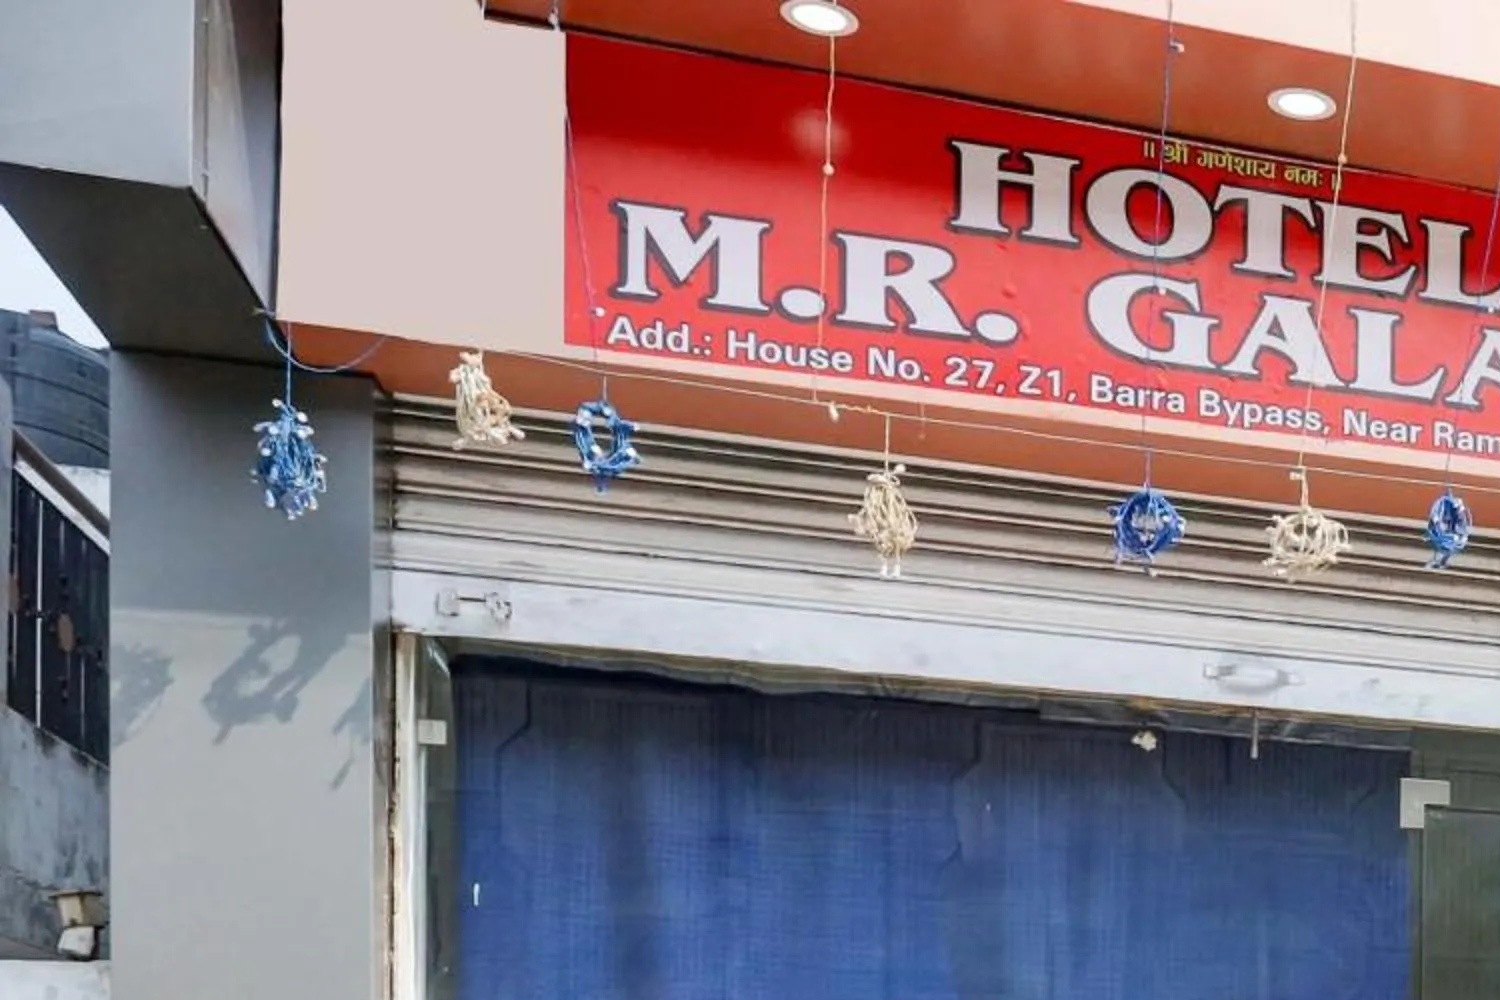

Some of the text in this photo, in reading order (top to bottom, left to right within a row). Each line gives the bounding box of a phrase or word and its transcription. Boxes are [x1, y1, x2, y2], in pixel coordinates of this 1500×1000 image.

[1197, 149, 1276, 180] गणेशाय
[611, 200, 1020, 345] M.R.
[607, 315, 713, 356] Add.:
[727, 329, 854, 373] House
[867, 346, 933, 383] No.
[944, 356, 1006, 394] 27,
[1018, 364, 1078, 403] Z1,
[1090, 373, 1186, 414] Barra
[1199, 388, 1332, 437] Bypass,
[1343, 408, 1423, 444] Near
